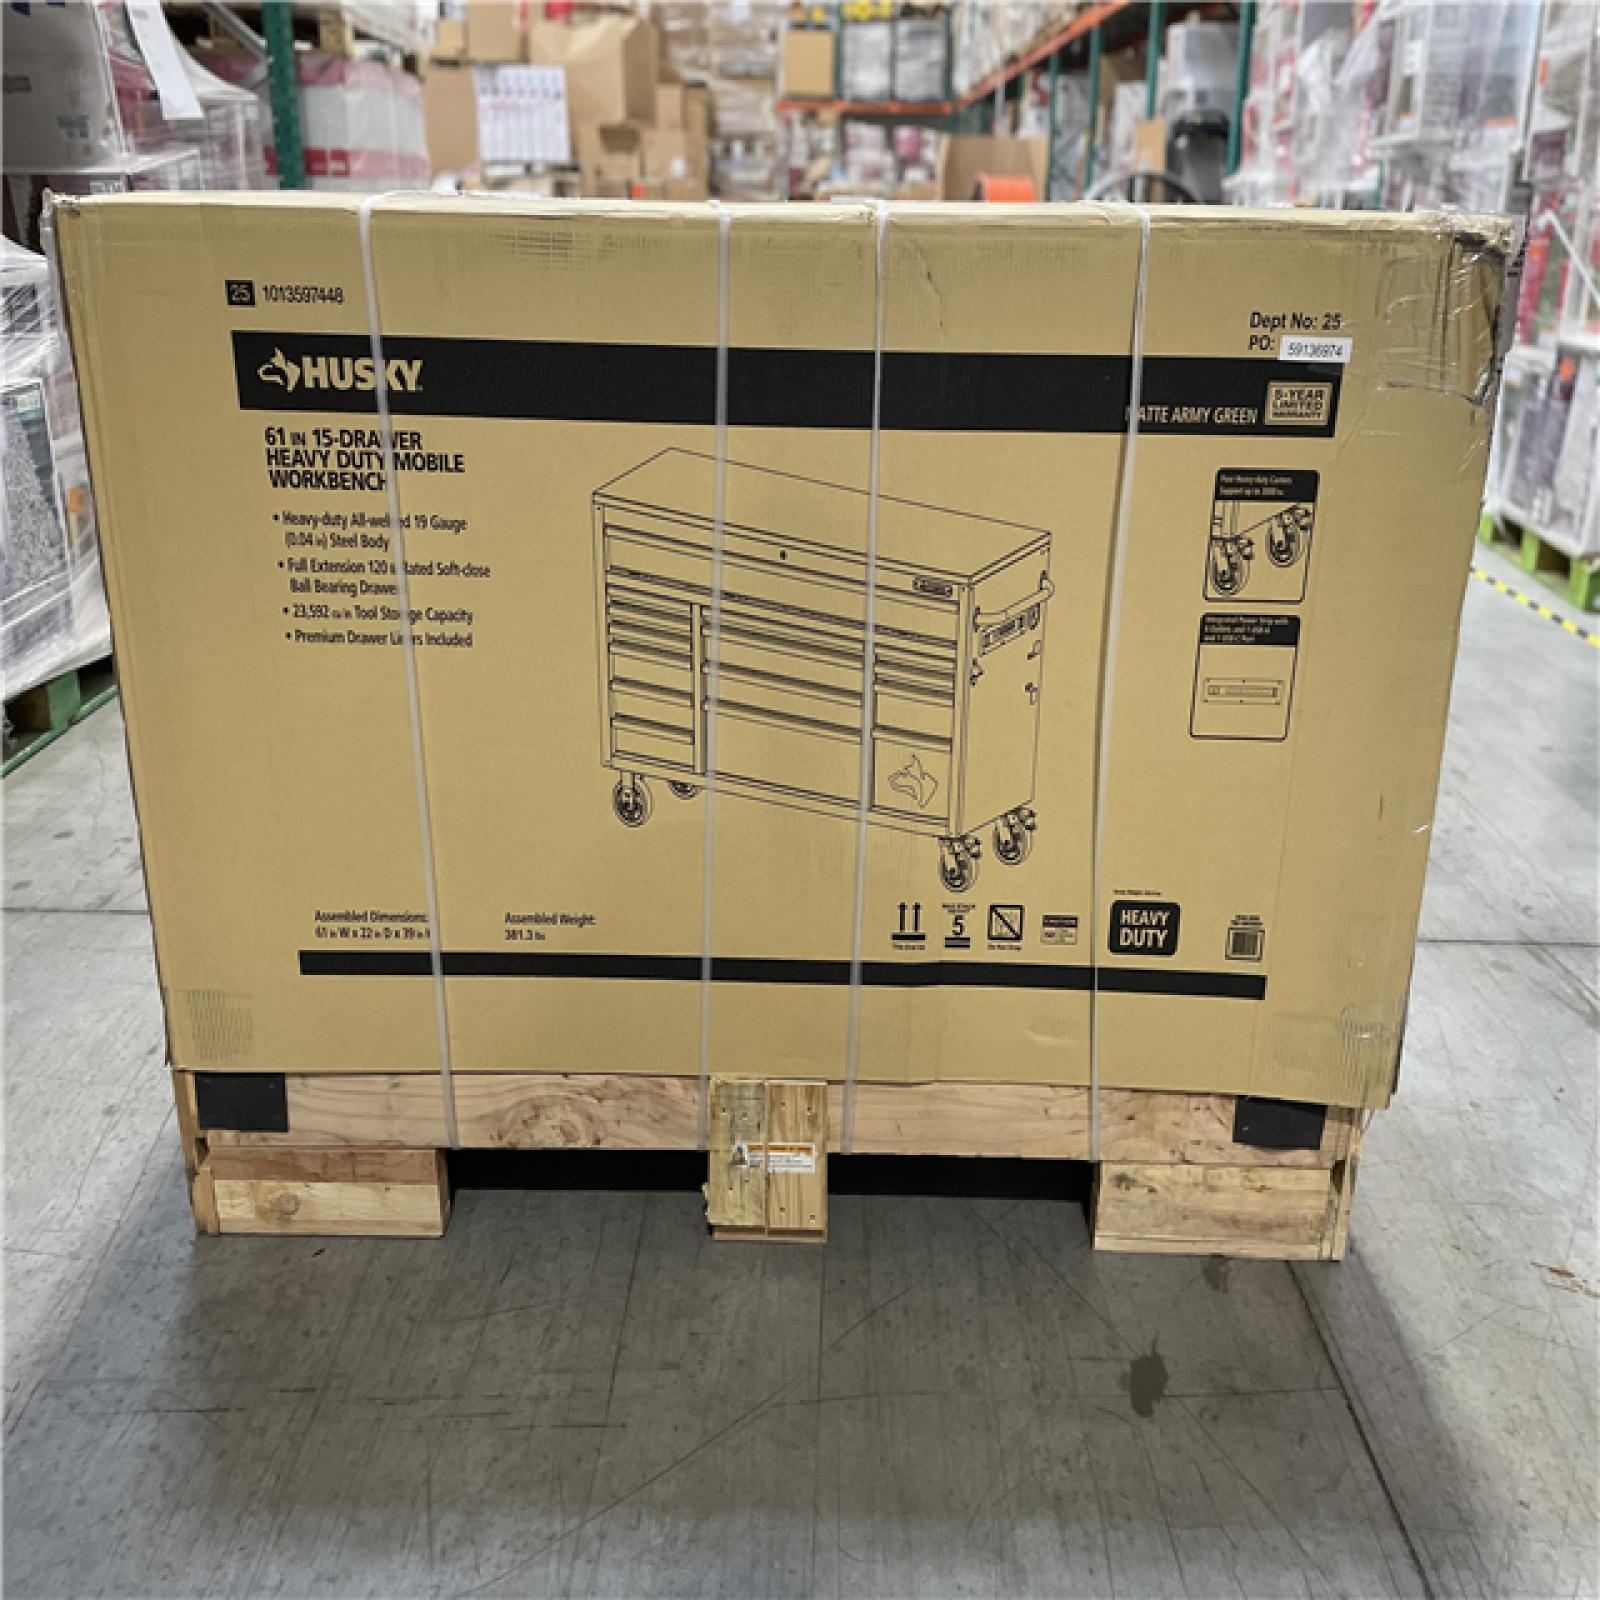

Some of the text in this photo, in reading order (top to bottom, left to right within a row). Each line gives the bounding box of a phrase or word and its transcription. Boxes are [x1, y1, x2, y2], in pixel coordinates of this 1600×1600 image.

[262, 285, 344, 304] 1013597448
[1250, 312, 1342, 332] Dept No: 25
[1248, 335, 1275, 350] PO:
[302, 356, 423, 392] HUSKY
[1171, 406, 1211, 424] ARMY
[1214, 408, 1258, 425] GREEN
[1273, 401, 1323, 411] LIMITED
[264, 427, 285, 446] 61
[291, 432, 306, 446] IN
[267, 448, 466, 474] HEAVY DUTY MOBILE
[282, 510, 348, 530] Heavy-duty
[415, 514, 428, 529] 19
[430, 515, 468, 535] Gauge
[329, 532, 358, 548] Steel
[360, 533, 391, 552] Body
[287, 557, 308, 573] Full
[310, 558, 366, 573] Extension
[436, 562, 491, 578] Soft-close
[290, 577, 311, 593] Ball
[314, 579, 358, 597] Bearing
[354, 605, 378, 620] Tool
[425, 607, 473, 626] Capacity
[294, 630, 346, 644] Premium
[347, 630, 387, 644] Drawer
[424, 632, 473, 647] Included
[315, 909, 368, 923] Assembled
[505, 912, 557, 926] Assembled
[951, 914, 965, 937] 5
[1119, 909, 1170, 927] HEAVY
[1118, 928, 1169, 949] DUTY
